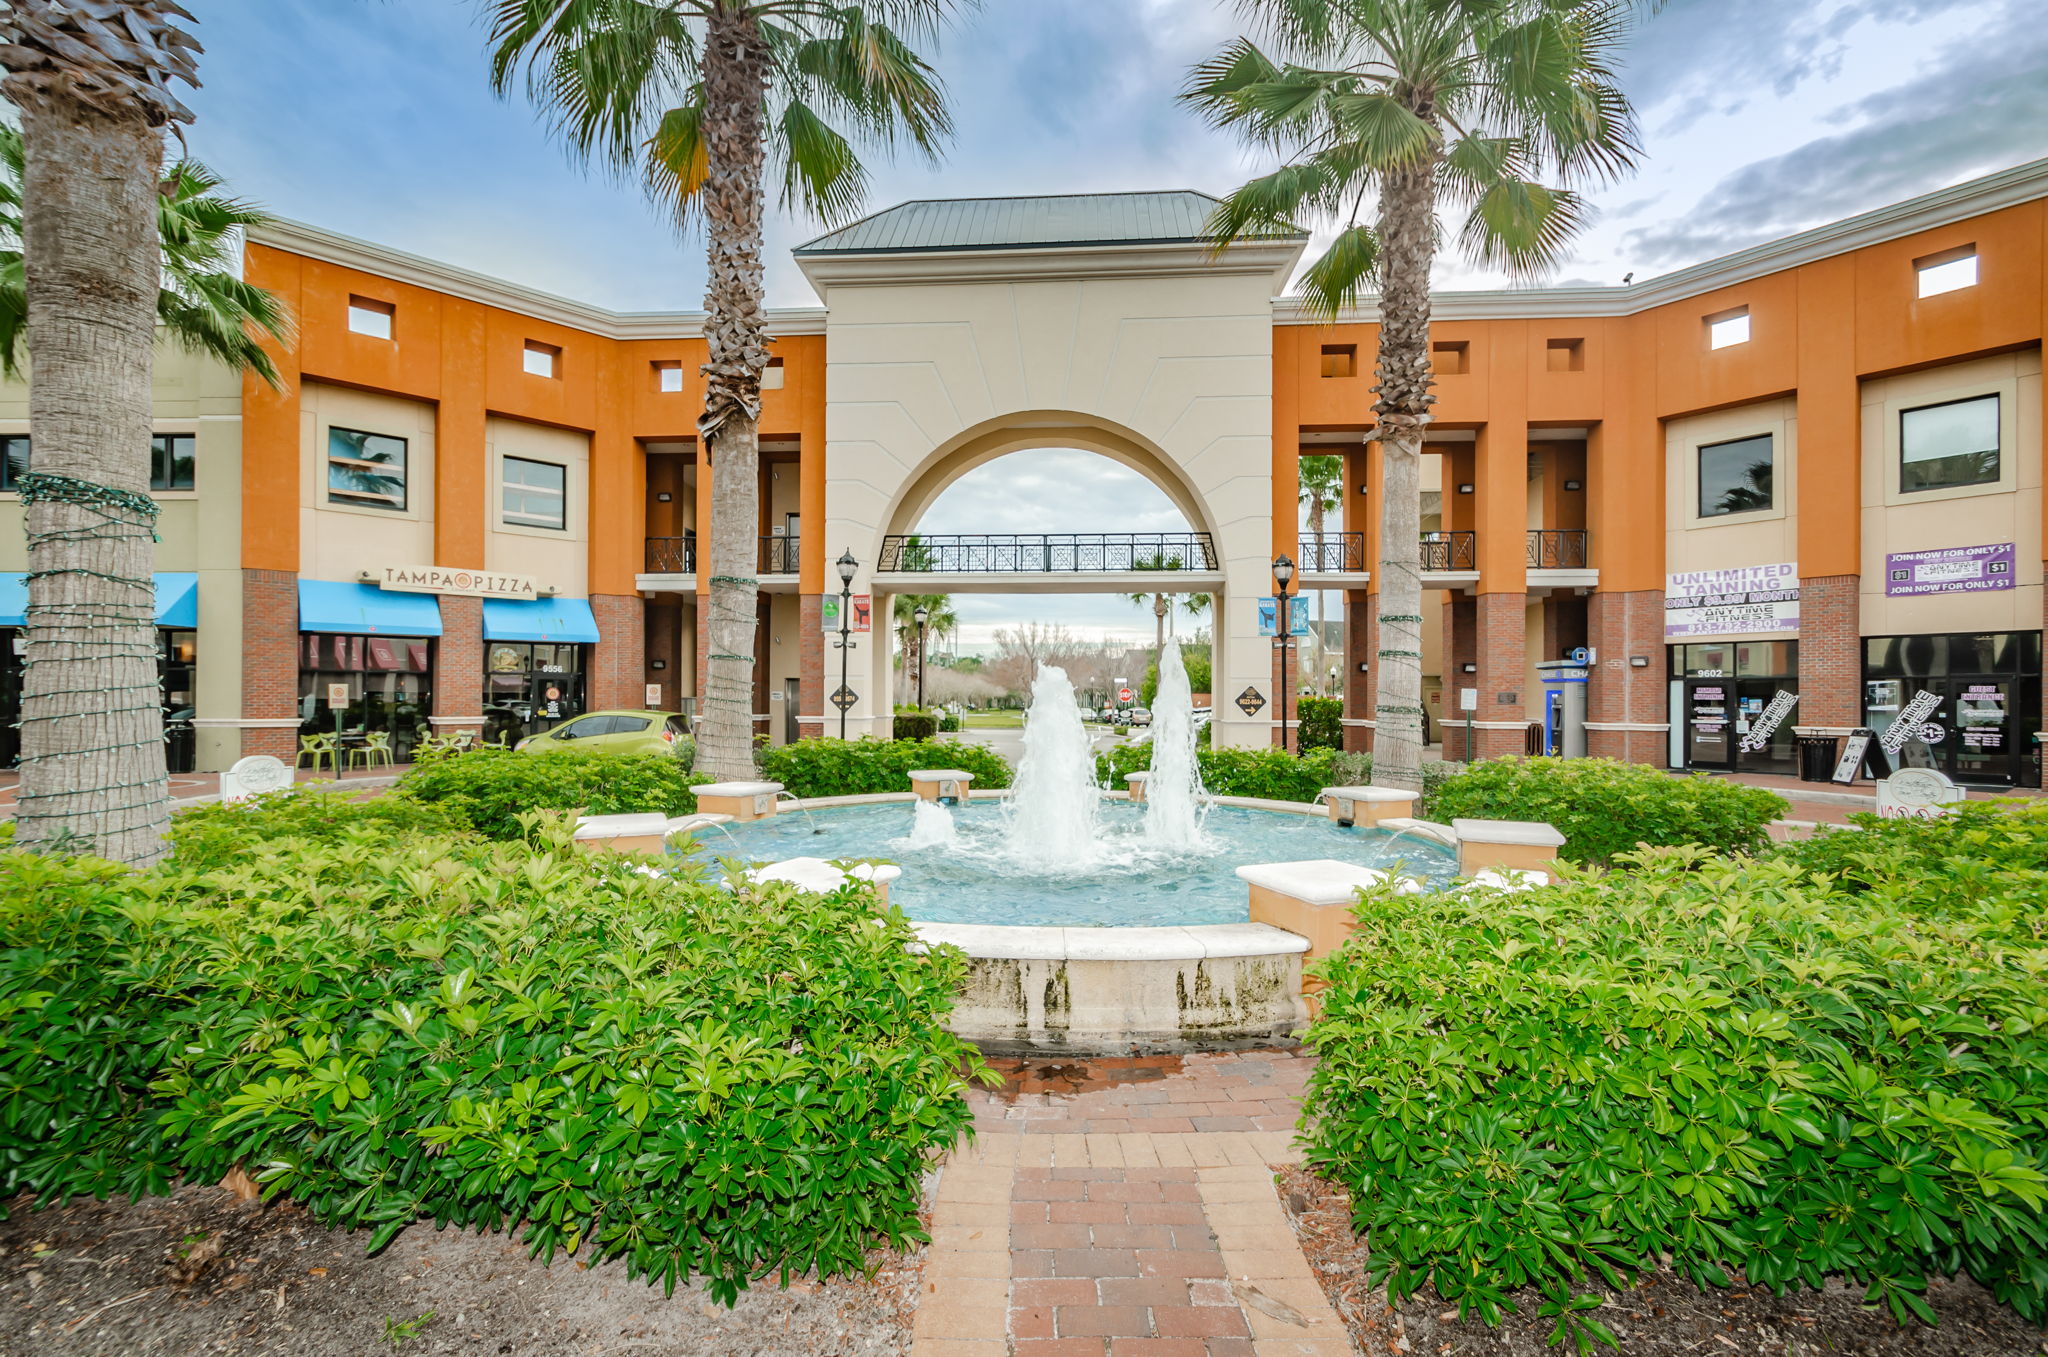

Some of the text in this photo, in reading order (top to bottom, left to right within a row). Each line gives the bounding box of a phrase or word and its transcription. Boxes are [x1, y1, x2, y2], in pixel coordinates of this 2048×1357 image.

[1891, 554, 1914, 562] JOIN
[1916, 551, 1941, 560] NOW
[1943, 549, 1964, 558] FOR
[1966, 546, 1997, 555] ONLY
[1997, 544, 2011, 553] $1
[1992, 563, 2006, 572] $1
[385, 568, 533, 593] TAMPA PIZZA
[1672, 564, 1793, 585] UNLIMITED
[1894, 571, 1908, 580] $1
[1682, 578, 1780, 596] TANNING
[1890, 579, 2010, 594] JOIN NOW FOR ONLY $1
[1665, 597, 1701, 608] ONLY
[1705, 604, 1774, 616] ANYTIME
[1706, 613, 1774, 622] FITNESS
[1688, 620, 1781, 632] 813-792-2900
[542, 664, 563, 673] 9556
[1697, 669, 1722, 677] 9602
